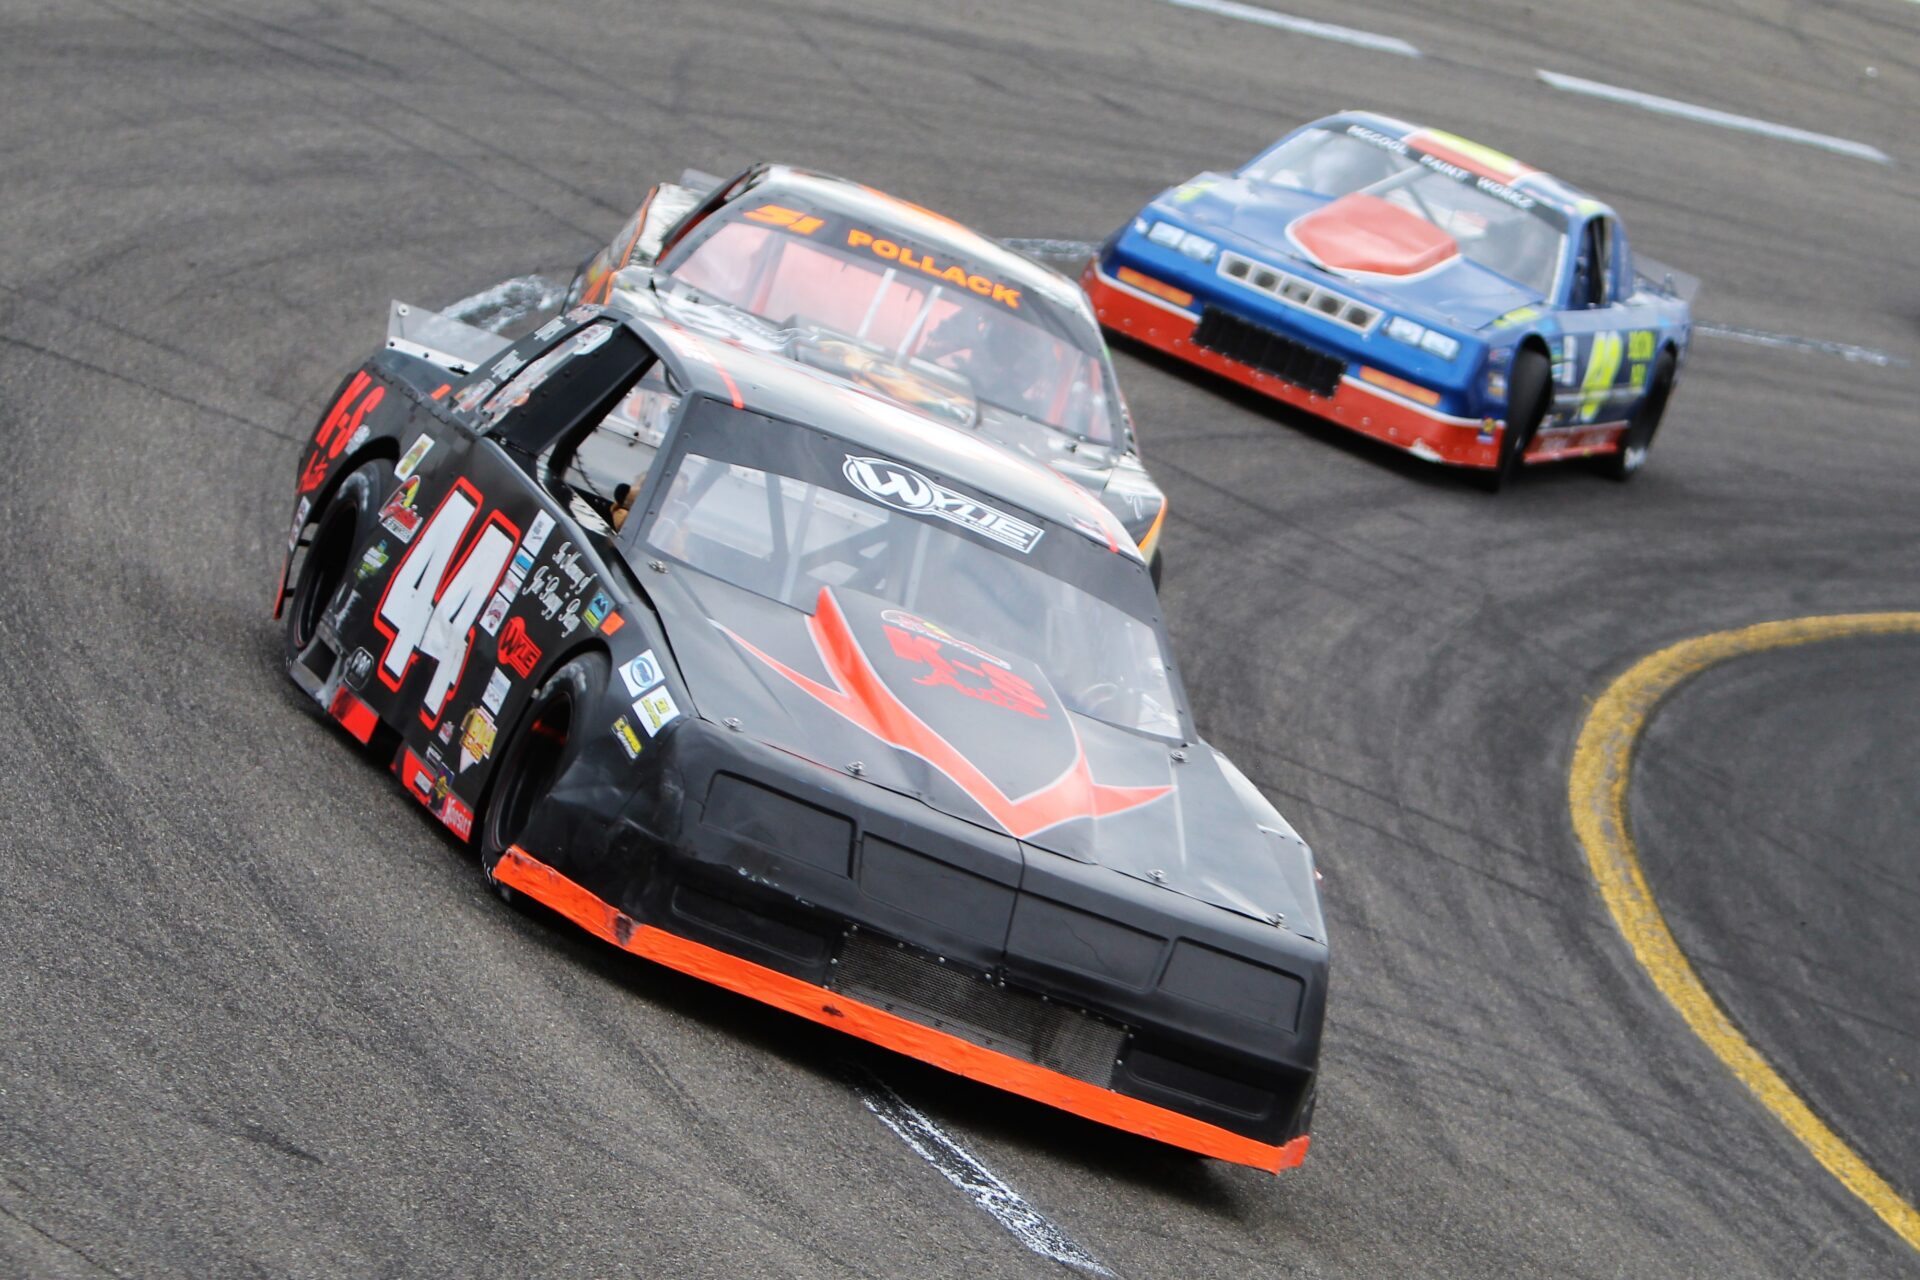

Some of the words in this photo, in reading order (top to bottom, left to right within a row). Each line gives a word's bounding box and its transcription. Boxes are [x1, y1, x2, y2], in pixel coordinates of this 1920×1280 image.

[1419, 153, 1472, 183] PAINT
[847, 229, 1021, 309] POLLACK
[374, 476, 521, 730] 44
